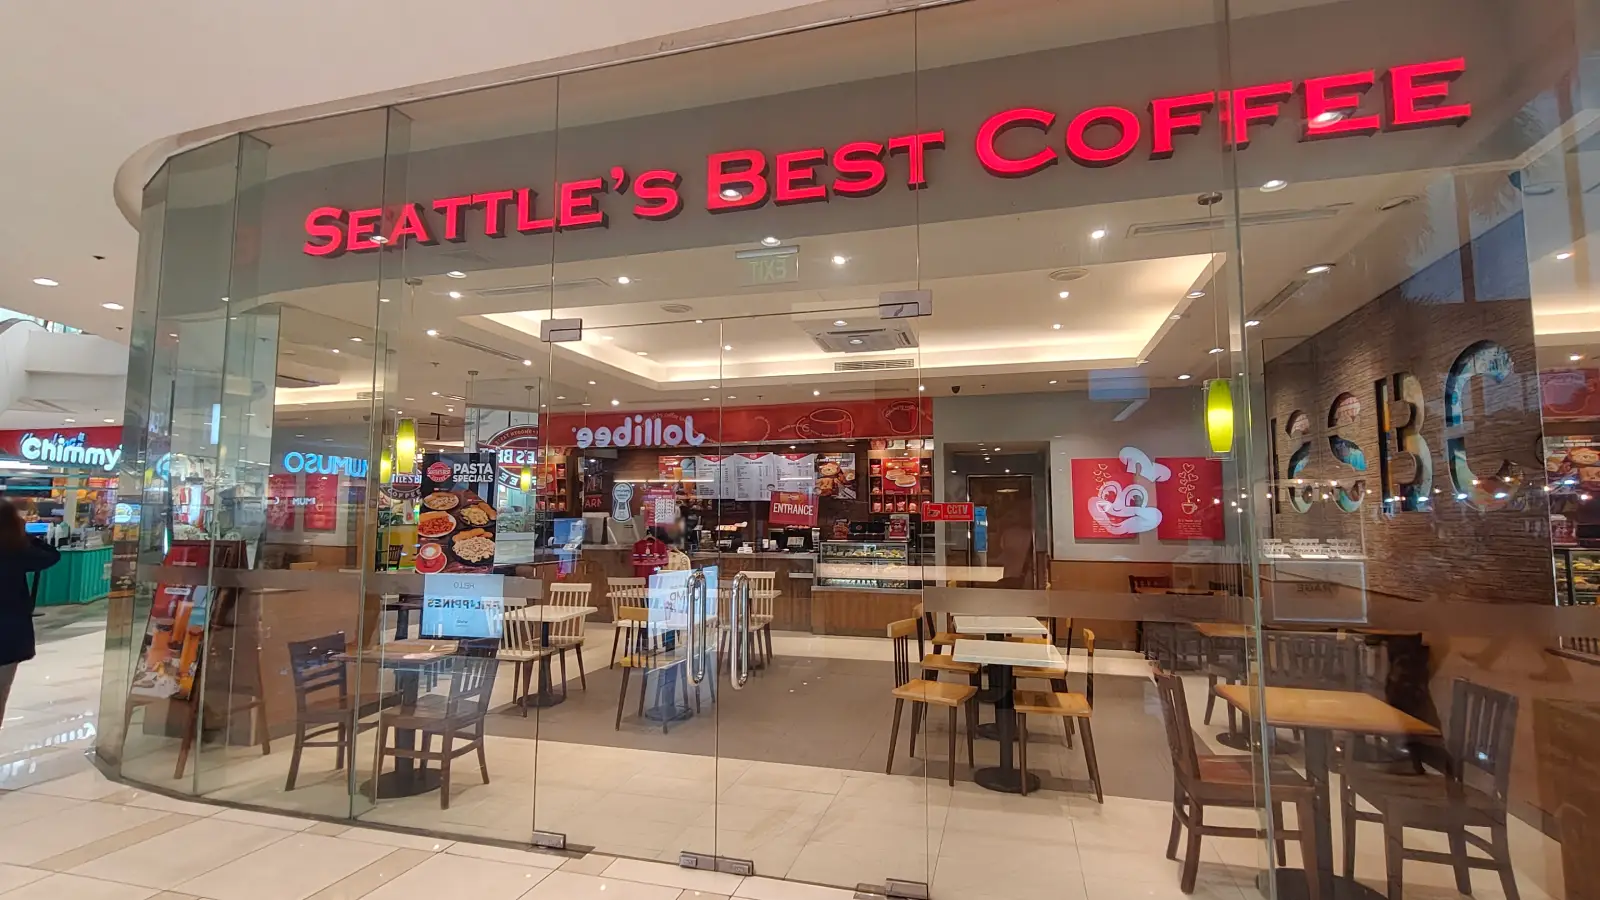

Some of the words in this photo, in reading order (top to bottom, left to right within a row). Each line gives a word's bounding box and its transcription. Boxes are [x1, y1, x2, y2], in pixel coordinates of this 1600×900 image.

[303, 166, 680, 257] SEATTLE'S
[706, 129, 946, 214] BEST
[974, 56, 1473, 178] COFFEE
[453, 462, 494, 475] PASTA
[452, 474, 494, 483] SPECIALS
[773, 502, 814, 516] ENTRANCE
[946, 504, 968, 515] CCTV
